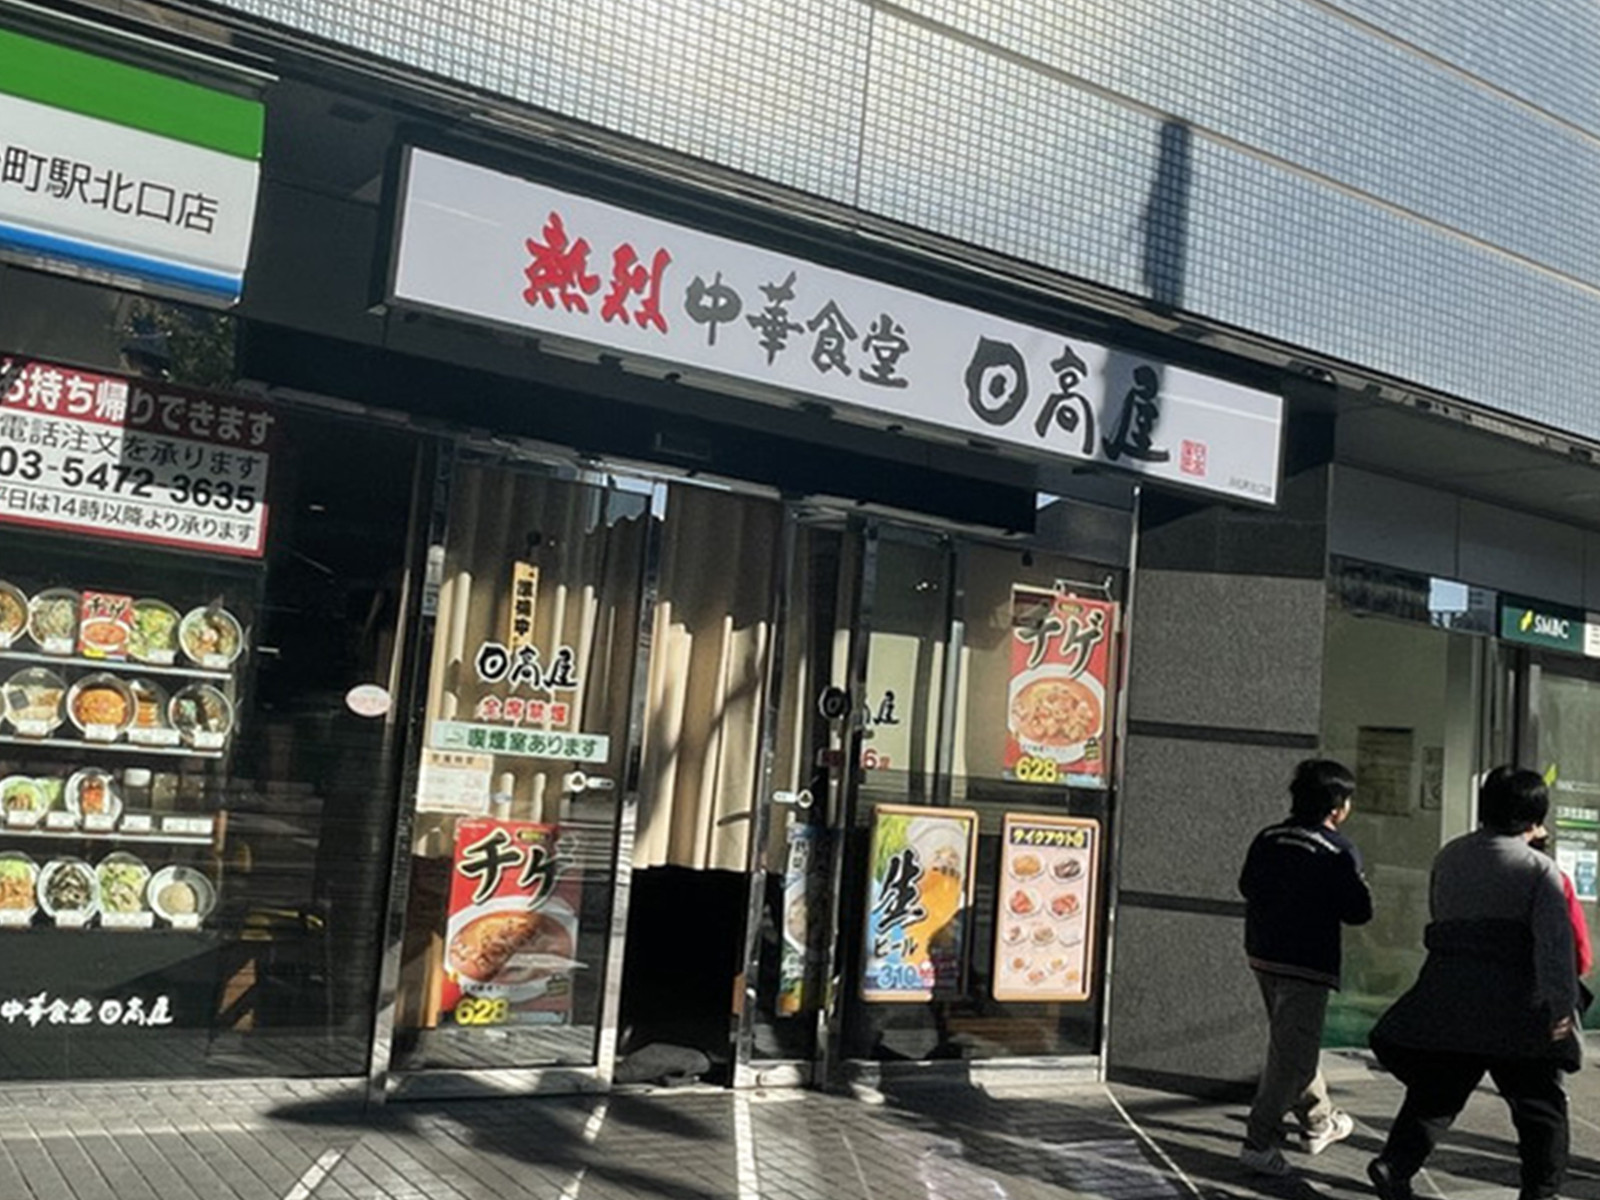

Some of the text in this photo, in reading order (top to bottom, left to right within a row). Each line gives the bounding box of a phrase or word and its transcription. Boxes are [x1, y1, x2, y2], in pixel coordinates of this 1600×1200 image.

[0, 146, 218, 234] 町駅北口店
[684, 271, 909, 388] 中華食堂
[964, 335, 1170, 462] 日高屋
[0, 412, 260, 479] 電話注文を承ります
[0, 446, 256, 513] 03-5472-3635
[1013, 600, 1104, 678] チゲ
[1533, 614, 1570, 640] SMBC
[476, 645, 577, 688] 日高屋
[468, 728, 597, 758] 喫煙室あります
[1016, 757, 1056, 783] 628
[873, 848, 926, 930] 生
[878, 963, 917, 989] 310
[1, 992, 173, 1027] 中華食堂 日高屋
[455, 998, 508, 1025] 628
